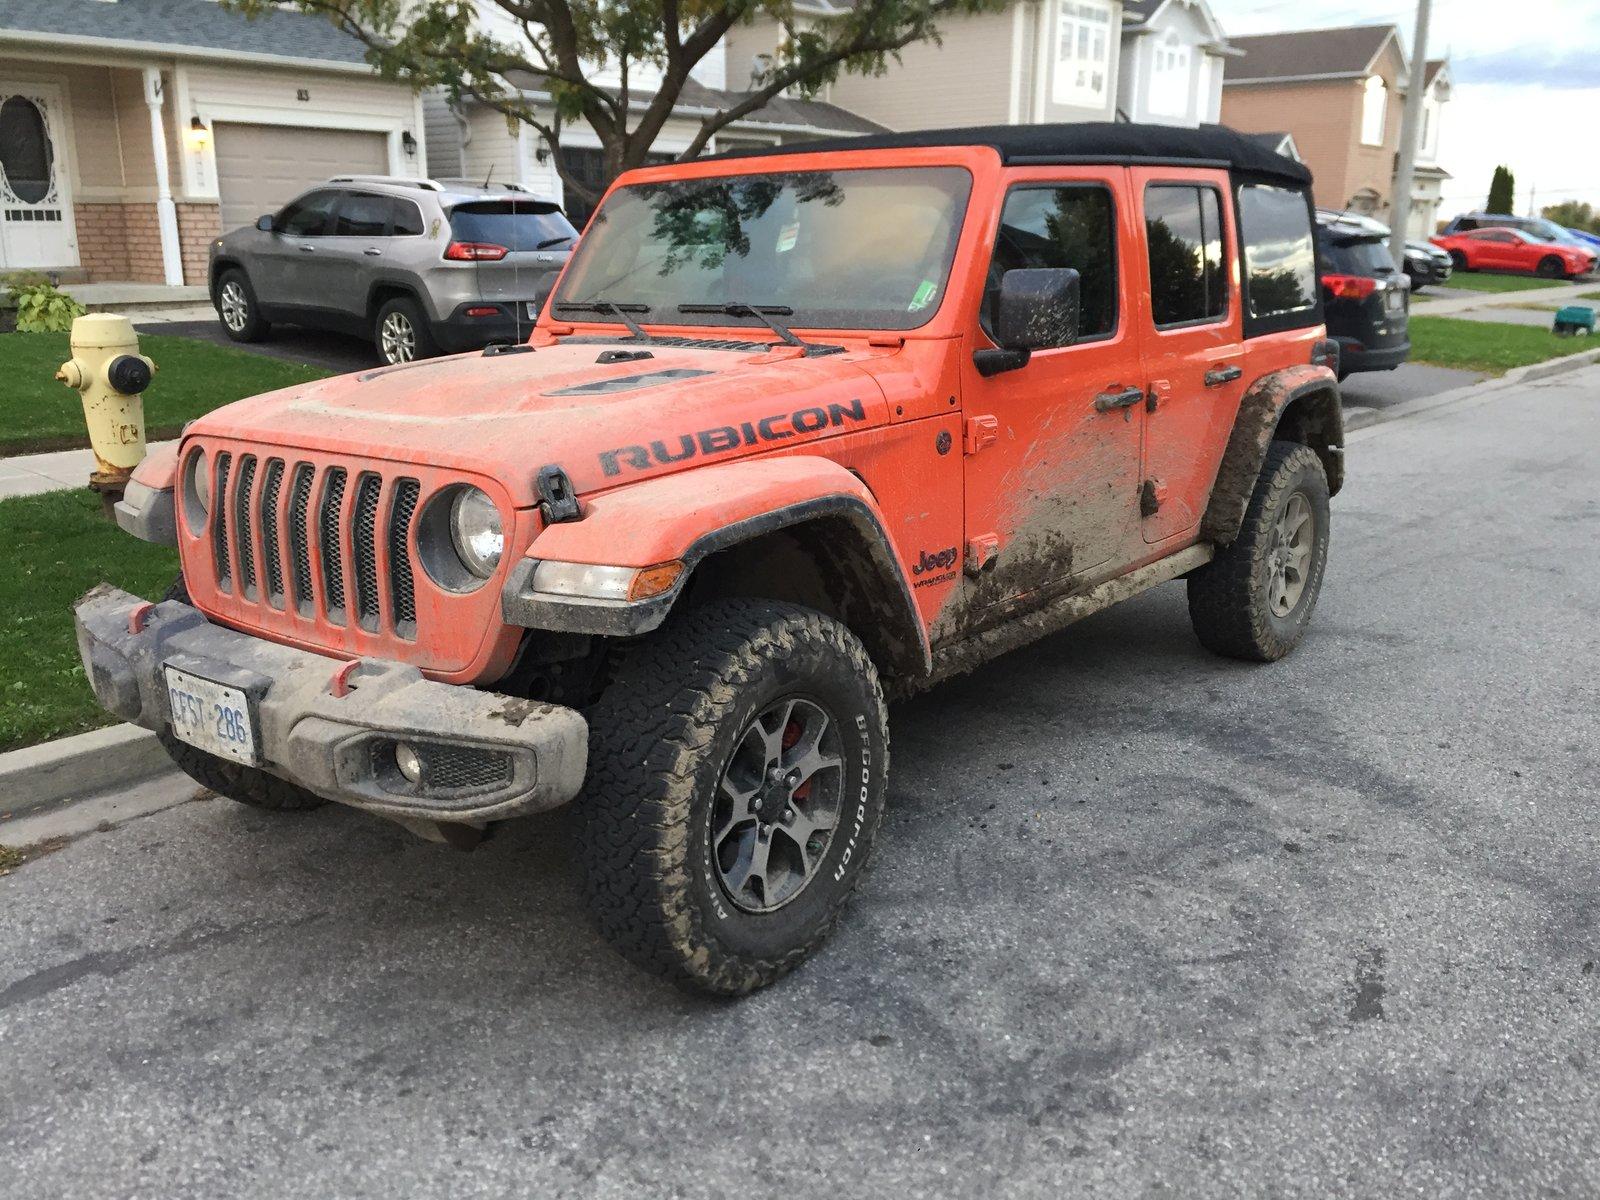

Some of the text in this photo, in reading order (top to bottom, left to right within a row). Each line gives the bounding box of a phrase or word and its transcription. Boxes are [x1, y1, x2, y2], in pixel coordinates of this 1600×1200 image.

[598, 398, 866, 477] RUBICON
[912, 546, 958, 576] Jeep
[913, 570, 957, 589] WRANGLER
[214, 703, 247, 744] 286
[833, 713, 872, 883] BFGoodrich
